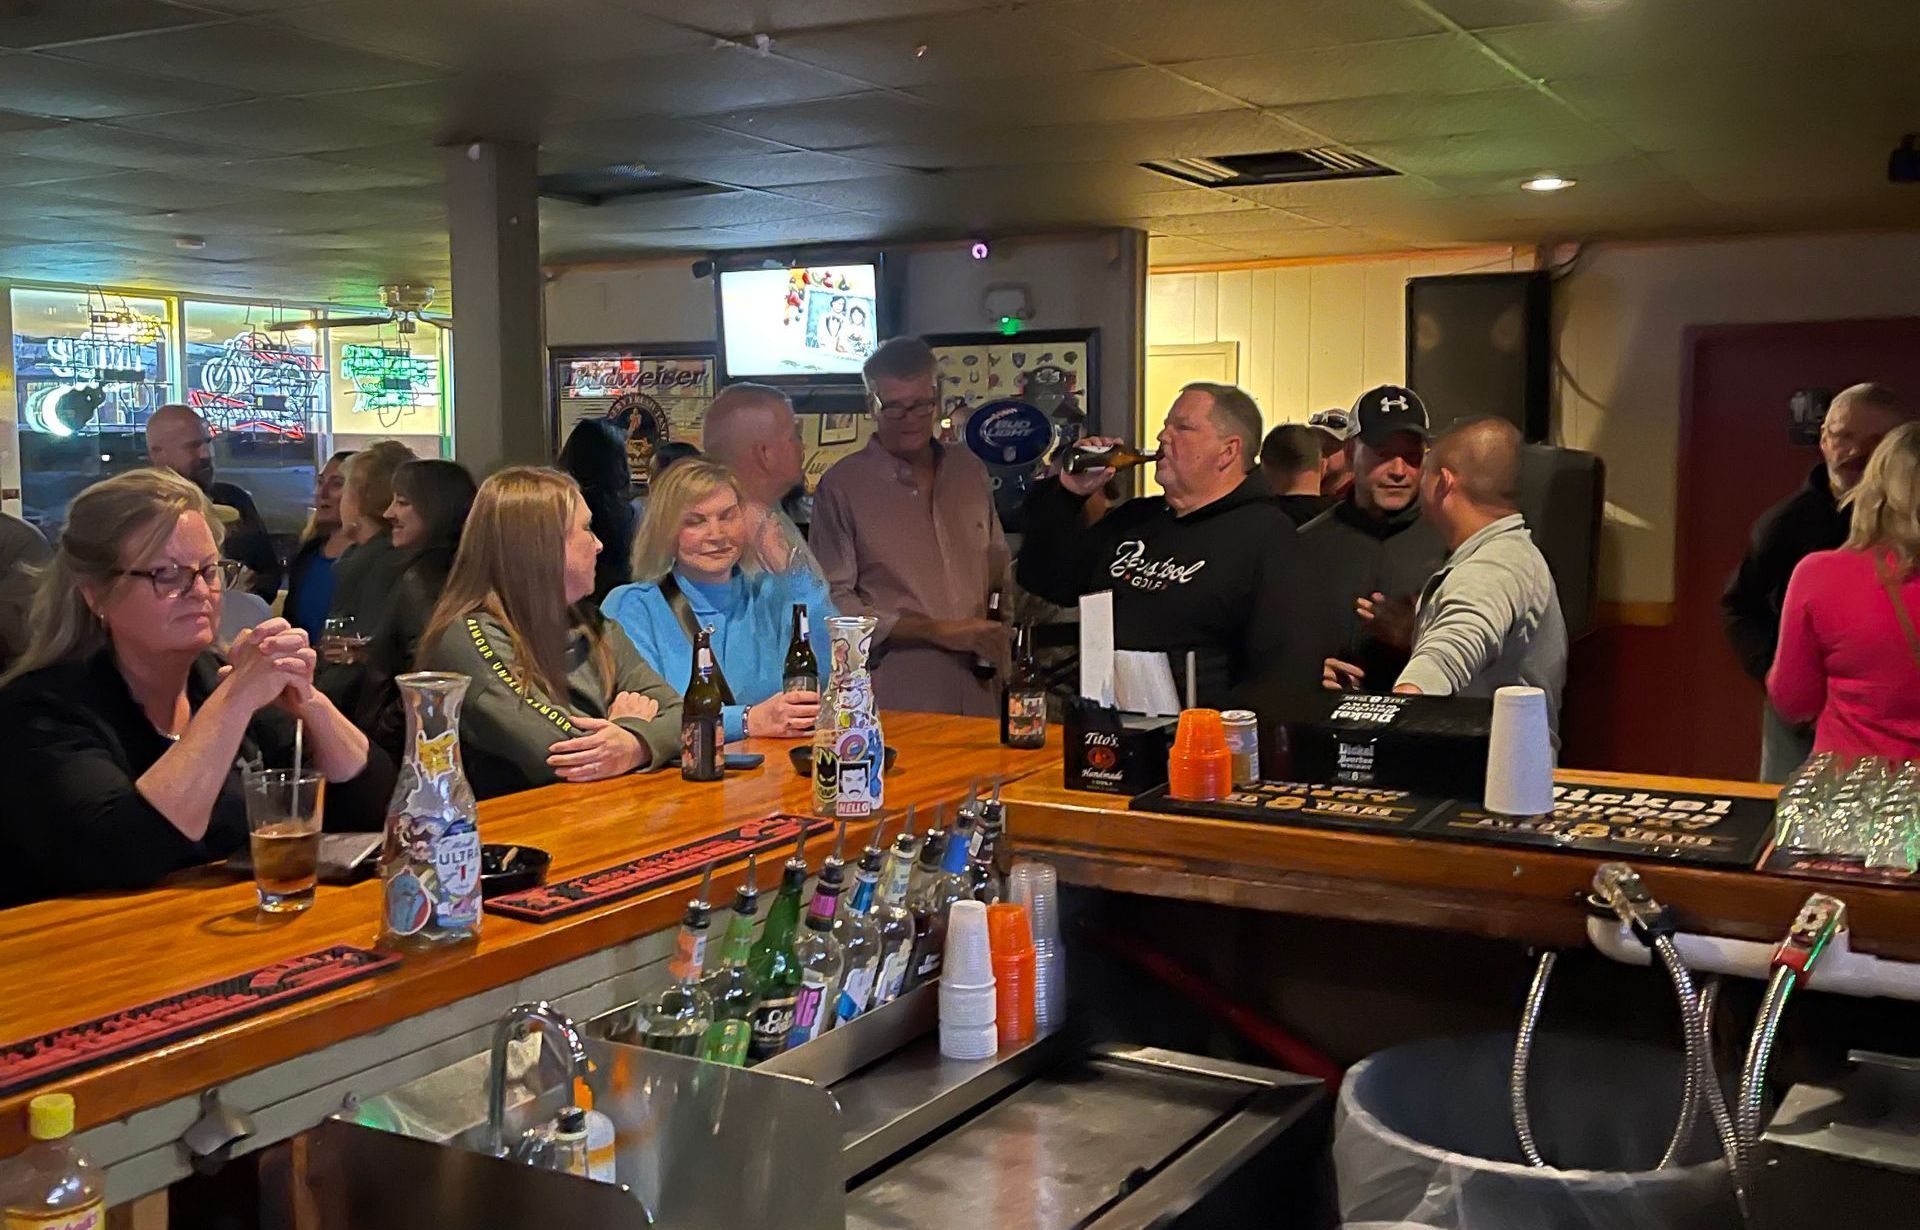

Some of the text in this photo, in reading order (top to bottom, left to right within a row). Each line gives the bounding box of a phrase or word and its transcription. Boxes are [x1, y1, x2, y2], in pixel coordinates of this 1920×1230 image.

[562, 361, 711, 390] Budweiser
[995, 420, 1032, 429] BUD
[987, 428, 1035, 437] LIGHT
[1331, 710, 1396, 723] Dickel
[1085, 731, 1119, 747] Tito's
